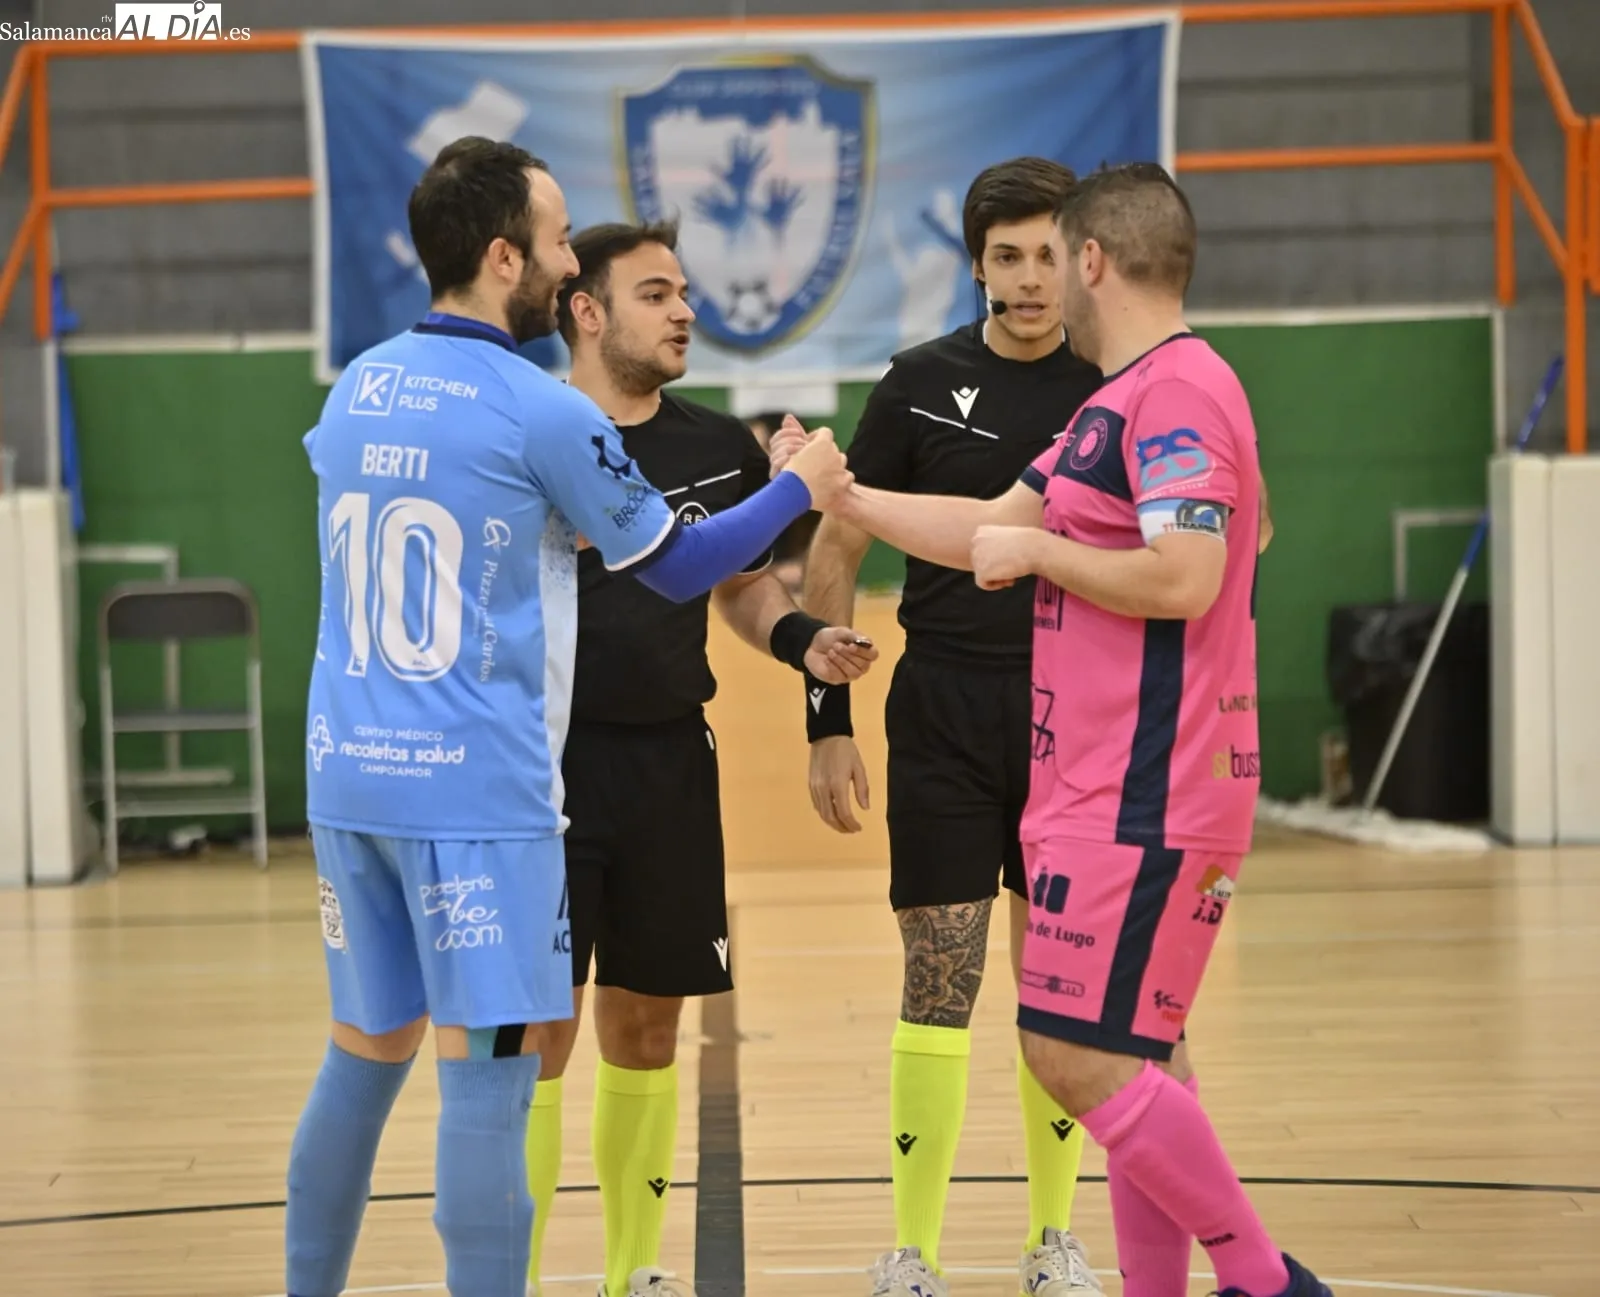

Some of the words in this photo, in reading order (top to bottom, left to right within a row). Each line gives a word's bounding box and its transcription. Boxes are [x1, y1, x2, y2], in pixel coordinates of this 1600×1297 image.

[404, 375, 479, 400] KITCHEN
[398, 394, 438, 411] PLUS
[361, 443, 429, 481] BERTI
[328, 492, 464, 682] 10
[354, 725, 393, 739] CENTRO
[396, 727, 444, 742] MÉDICO
[340, 740, 409, 762] recoletas
[414, 744, 466, 764] salud
[359, 762, 433, 778] CAMPOAMOR
[1036, 922, 1051, 939] de
[1055, 926, 1096, 949] Lugo
